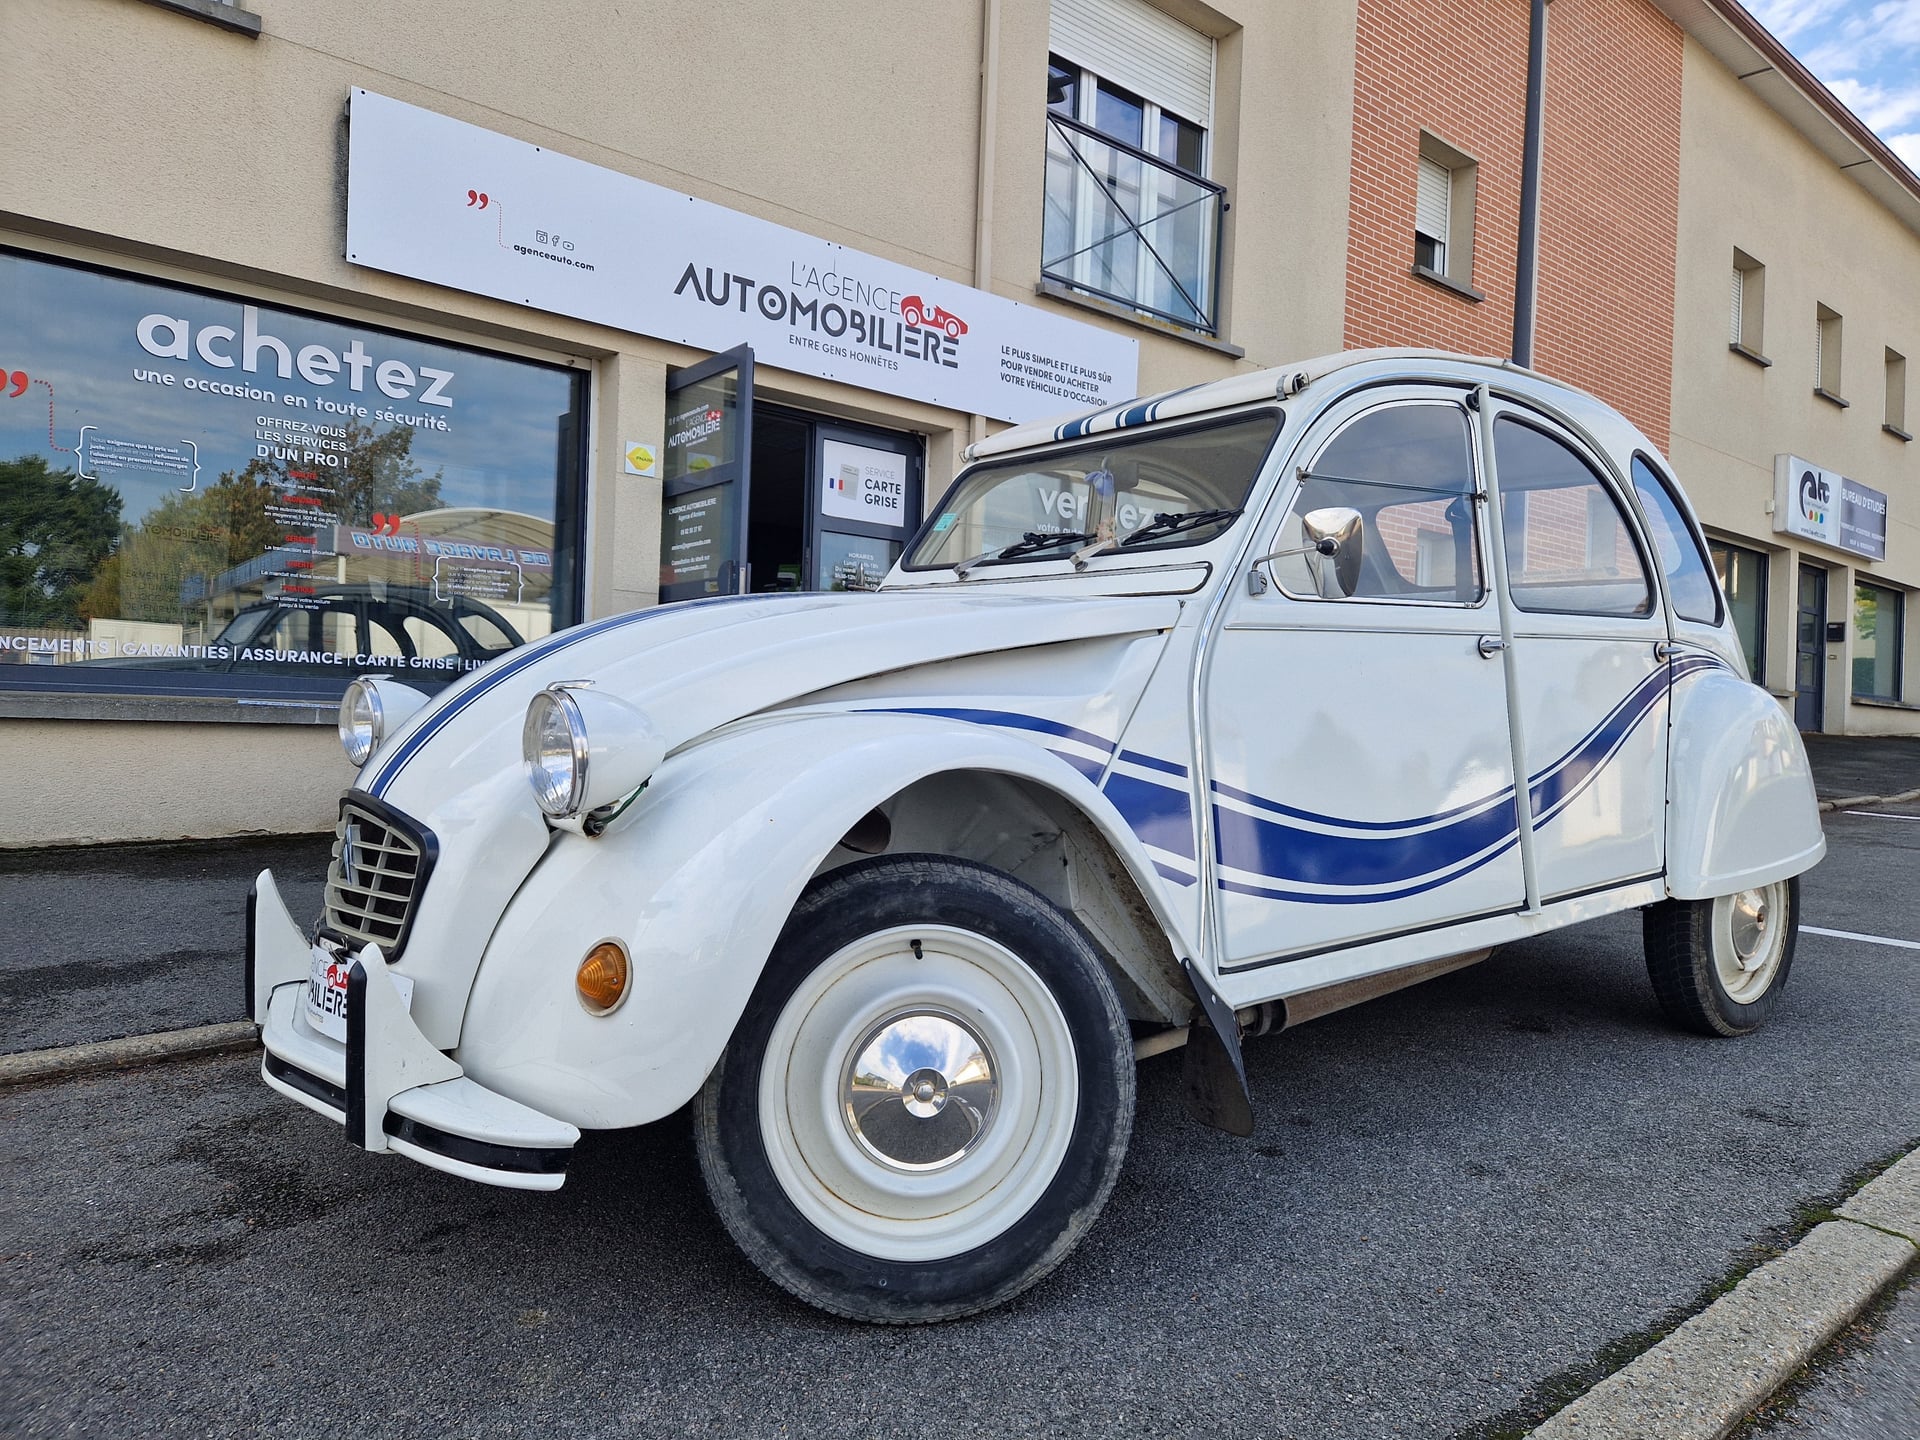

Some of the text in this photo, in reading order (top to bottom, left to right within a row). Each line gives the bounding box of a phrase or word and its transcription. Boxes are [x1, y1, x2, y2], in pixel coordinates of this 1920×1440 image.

[513, 242, 595, 272] agenceauto.com
[791, 260, 902, 316] L'AGENCE
[136, 305, 455, 408] achetez
[789, 334, 899, 371] ENTRE GENS HONNÊTES
[1001, 345, 1112, 384] LE PLUS SIMPLE ET LE PLUS SÛR
[1000, 358, 1099, 393] POUR VENDRE OU ACHETER
[1000, 372, 1025, 387] VOTRE
[1026, 378, 1062, 397] VÉHICULE
[132, 368, 452, 433] une occasion en toute sécurité.
[256, 415, 347, 439] OFFREZ-VOUS
[255, 429, 347, 452] LES SERVICES
[256, 444, 299, 464] D'UN
[303, 450, 339, 468] PRO
[865, 466, 895, 480] SERVICE
[864, 478, 902, 495] CARTE
[1841, 488, 1862, 508] BUREAU
[864, 493, 898, 509] GRISE
[1037, 522, 1060, 533] votre
[122, 641, 229, 660] GARANTIES
[240, 648, 343, 665] ASSURANCE
[354, 654, 406, 668] CARTE
[409, 656, 454, 671] GRISE
